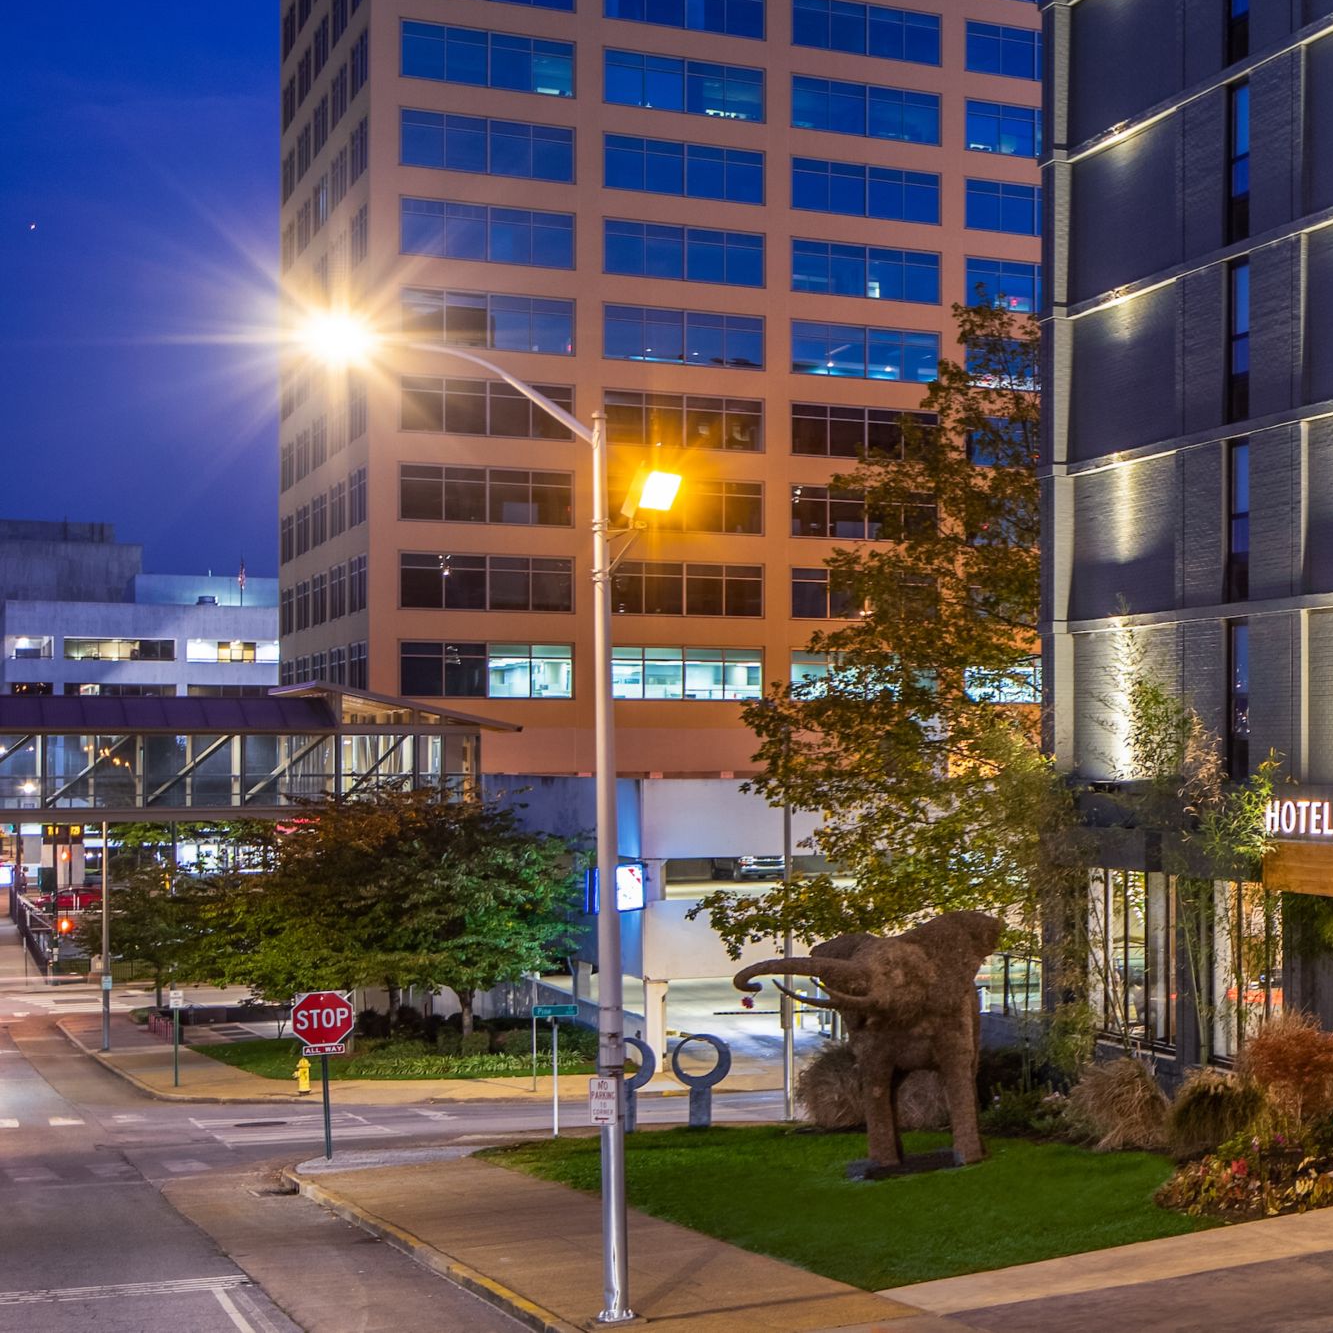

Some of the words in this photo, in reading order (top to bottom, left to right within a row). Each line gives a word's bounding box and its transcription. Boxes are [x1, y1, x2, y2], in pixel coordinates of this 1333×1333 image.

[1265, 799, 1333, 835] HOTEL
[296, 1007, 348, 1030] STOP
[324, 1045, 342, 1053] WAY
[597, 1081, 609, 1091] NO
[591, 1091, 616, 1100] PARKING
